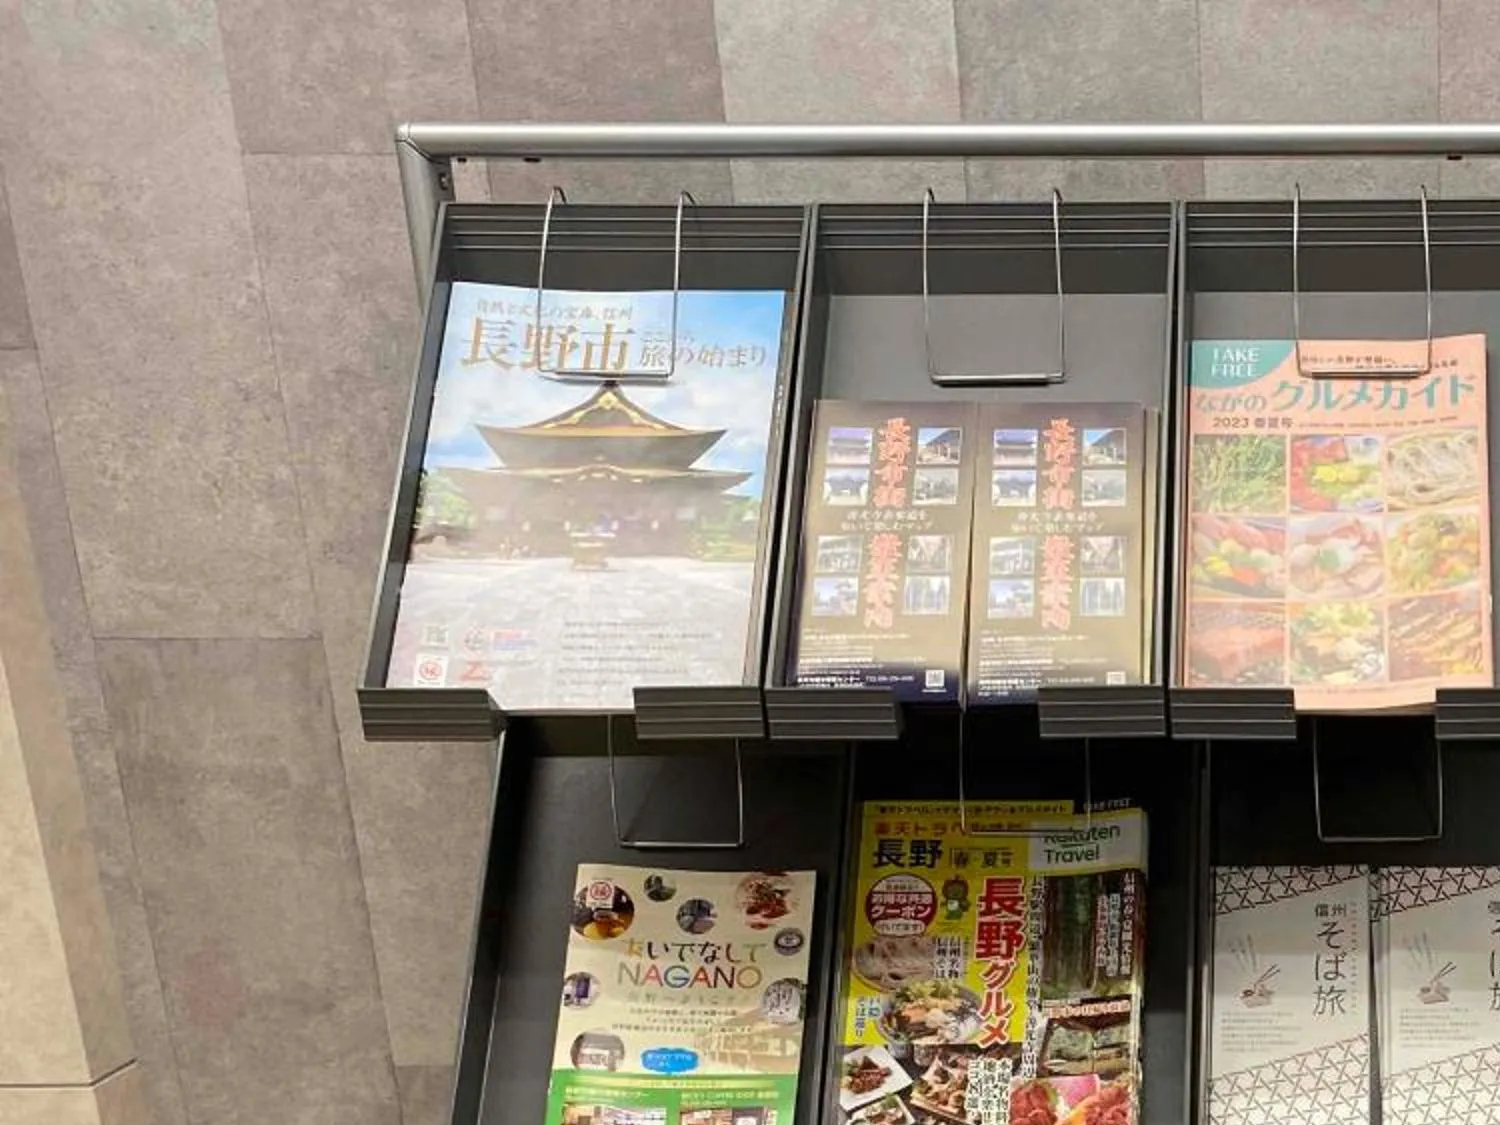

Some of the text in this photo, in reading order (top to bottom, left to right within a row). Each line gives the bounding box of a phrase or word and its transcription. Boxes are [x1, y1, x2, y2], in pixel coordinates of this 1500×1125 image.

[461, 316, 636, 371] 長野市
[1211, 347, 1260, 363] TAKE
[1212, 363, 1256, 378] FREE
[873, 838, 944, 869] 長野
[1045, 850, 1100, 865] Travel
[871, 904, 932, 919] クーポン
[1314, 902, 1347, 918] 信州
[975, 877, 1026, 1048] 長野グルメ
[1313, 920, 1347, 1017] そば旅
[617, 962, 763, 989] NAGANO
